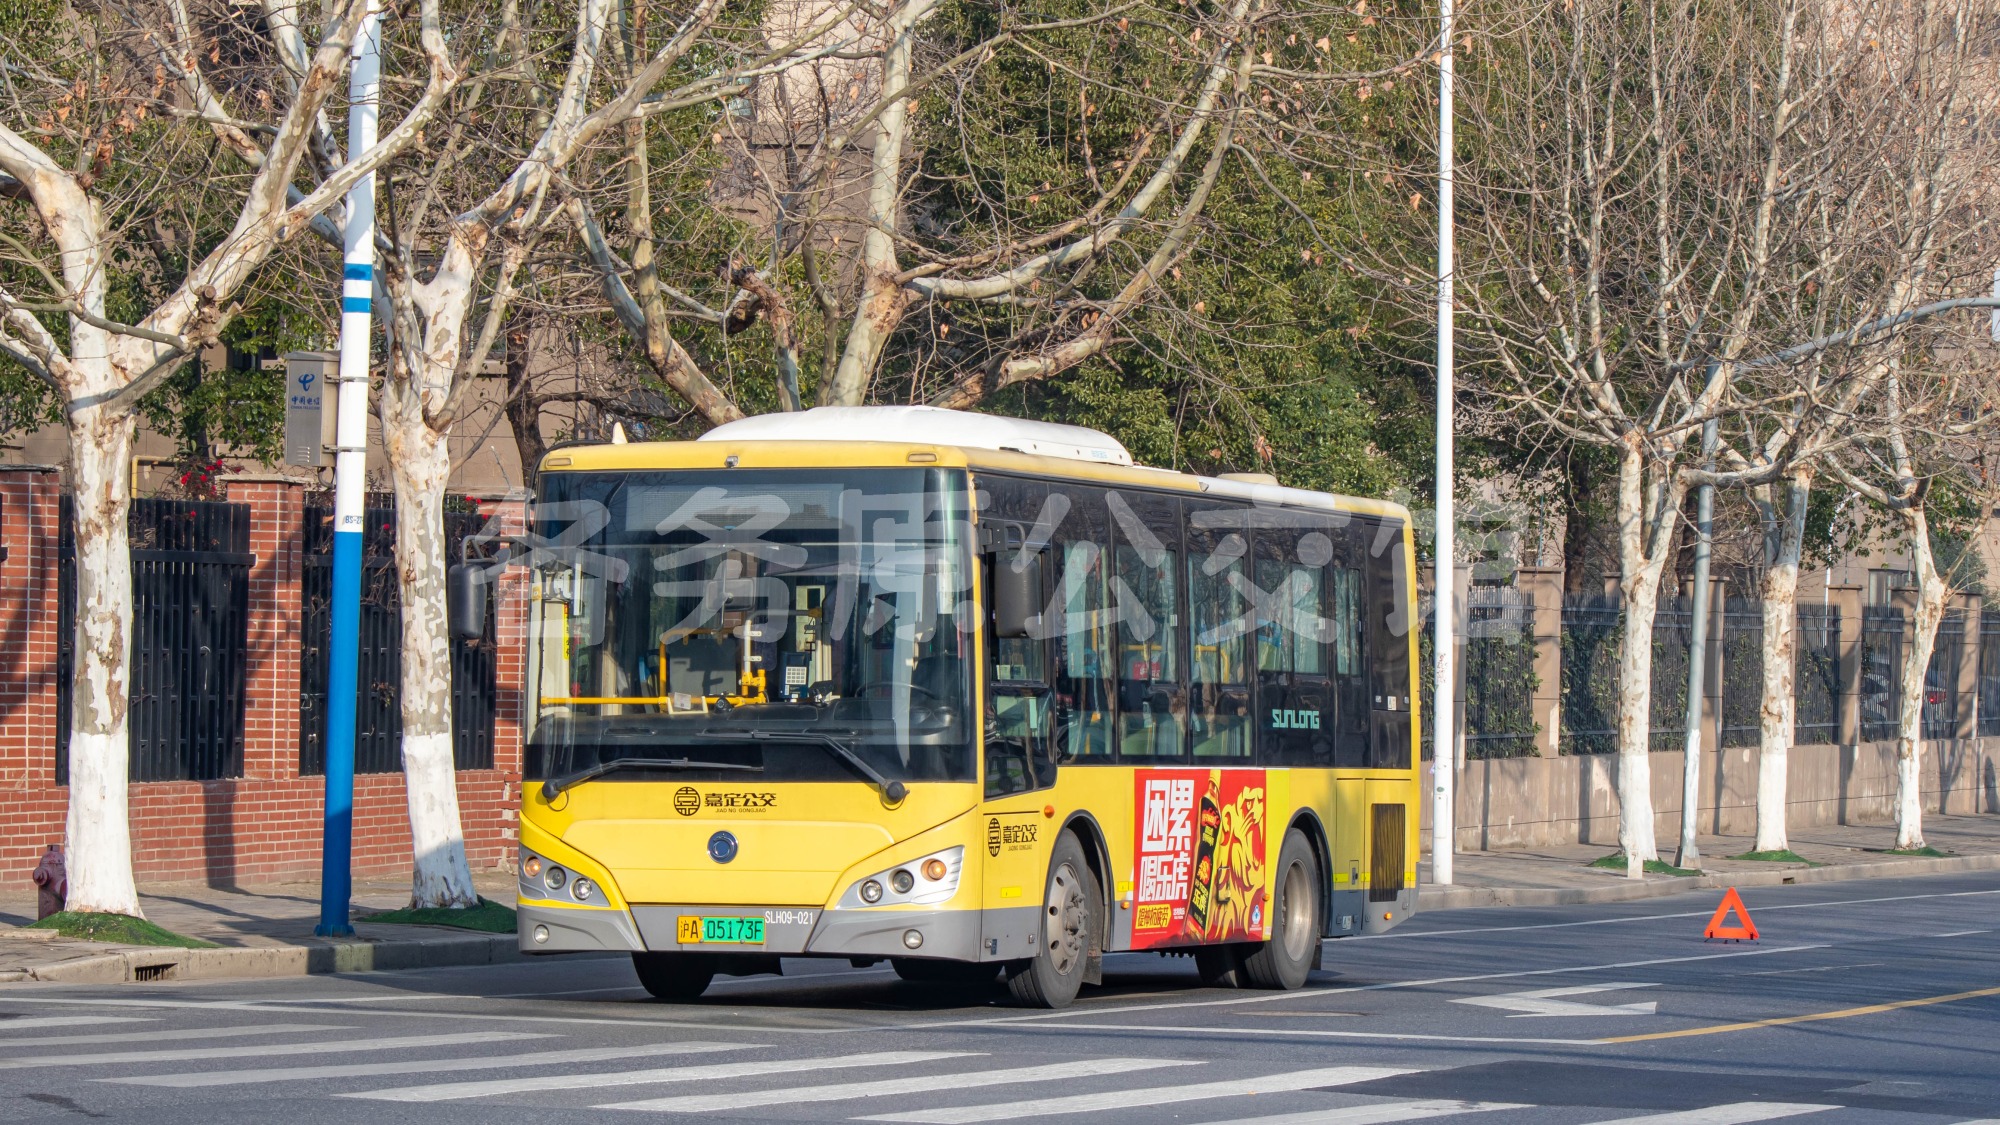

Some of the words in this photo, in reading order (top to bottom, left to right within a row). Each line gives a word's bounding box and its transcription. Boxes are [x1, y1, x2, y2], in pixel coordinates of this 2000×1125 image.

[1272, 709, 1320, 729] SUNLONG
[704, 793, 777, 807] 嘉定公交
[1141, 779, 1195, 852] 困累
[1003, 824, 1038, 844] 嘉定公交
[1138, 852, 1191, 902] 喝乐虎
[765, 910, 813, 924] SLH09-021
